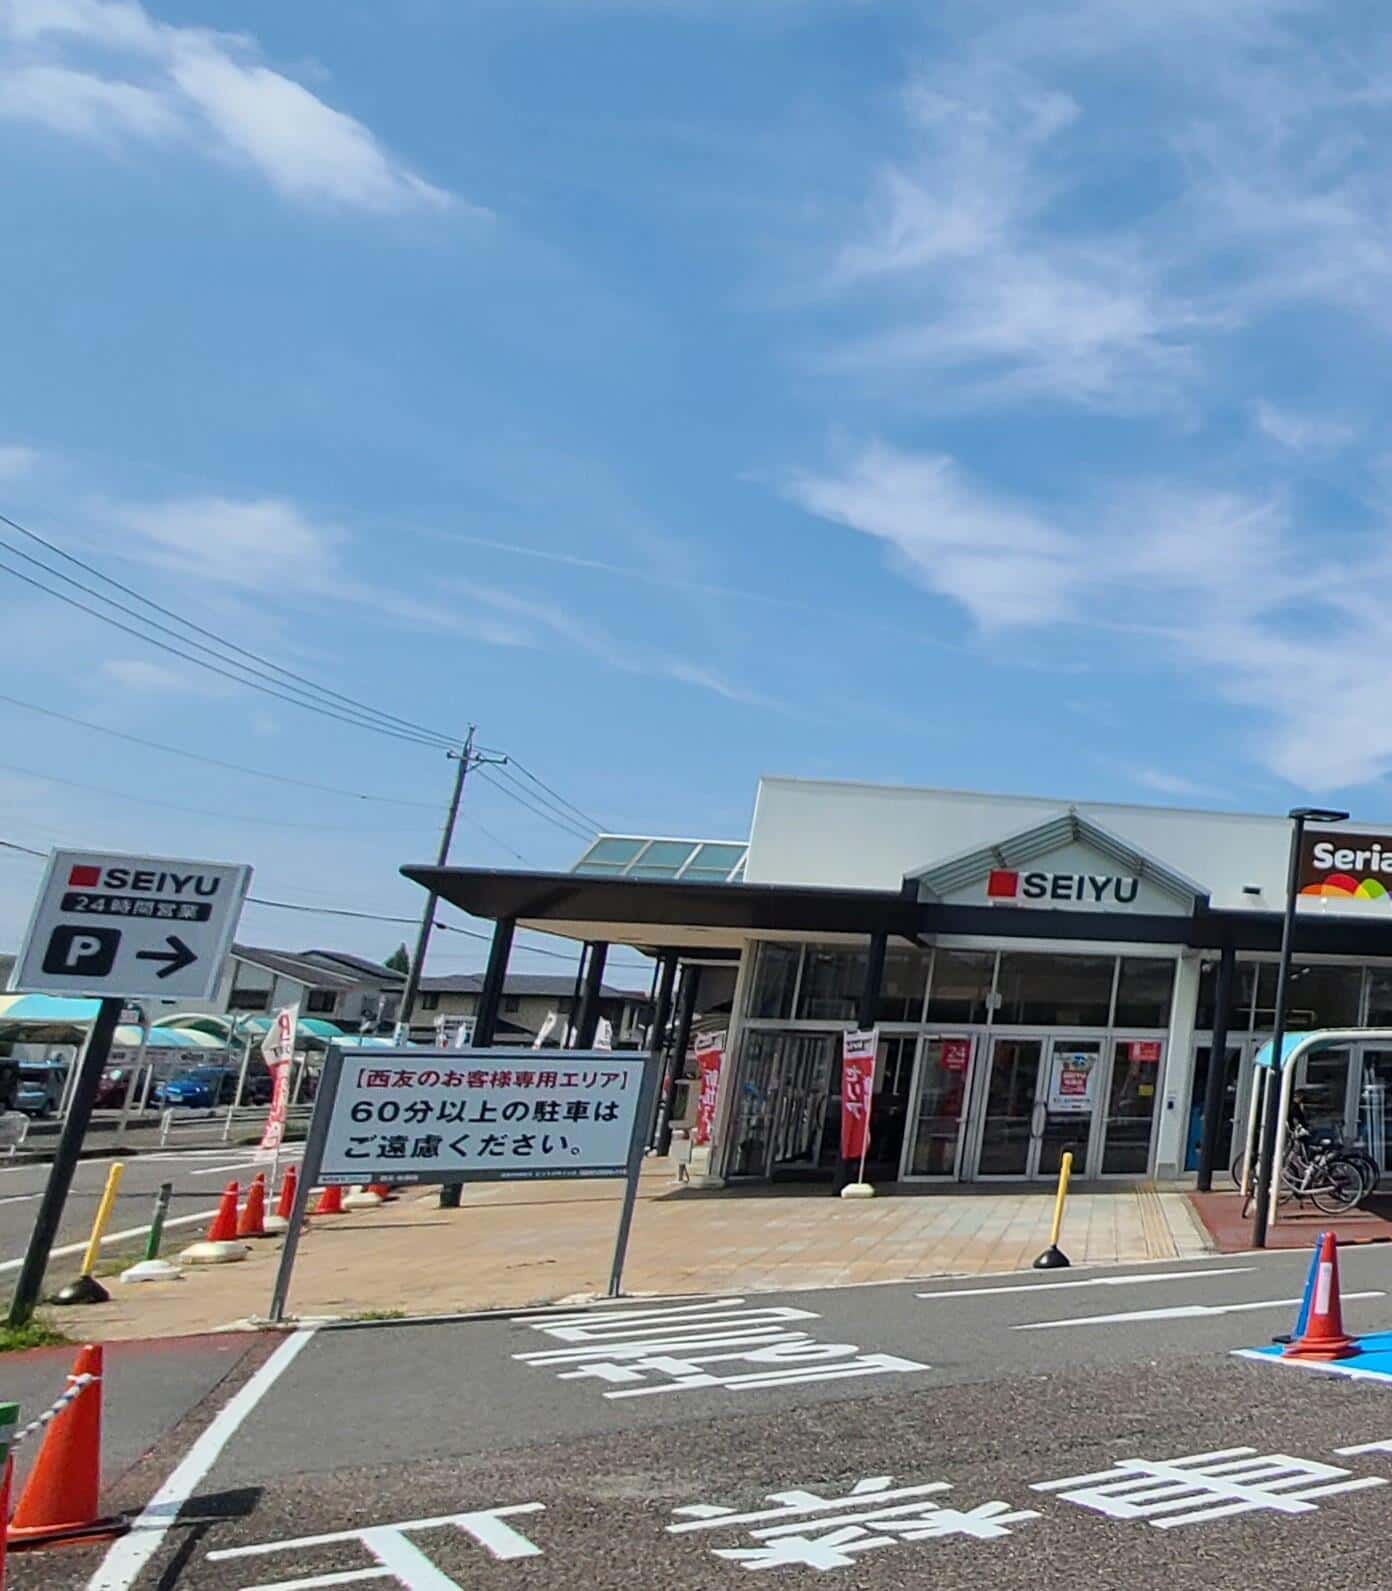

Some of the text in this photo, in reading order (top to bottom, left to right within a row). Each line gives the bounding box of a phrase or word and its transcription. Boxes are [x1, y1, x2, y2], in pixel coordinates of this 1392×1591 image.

[103, 868, 220, 896] SEIYU
[1022, 872, 1140, 903] SEIYU
[73, 897, 199, 919] 24時間営業
[64, 935, 101, 967] P
[350, 1100, 620, 1124] 60分以上の駐車は
[343, 1133, 582, 1159] ご遠慮ください。
